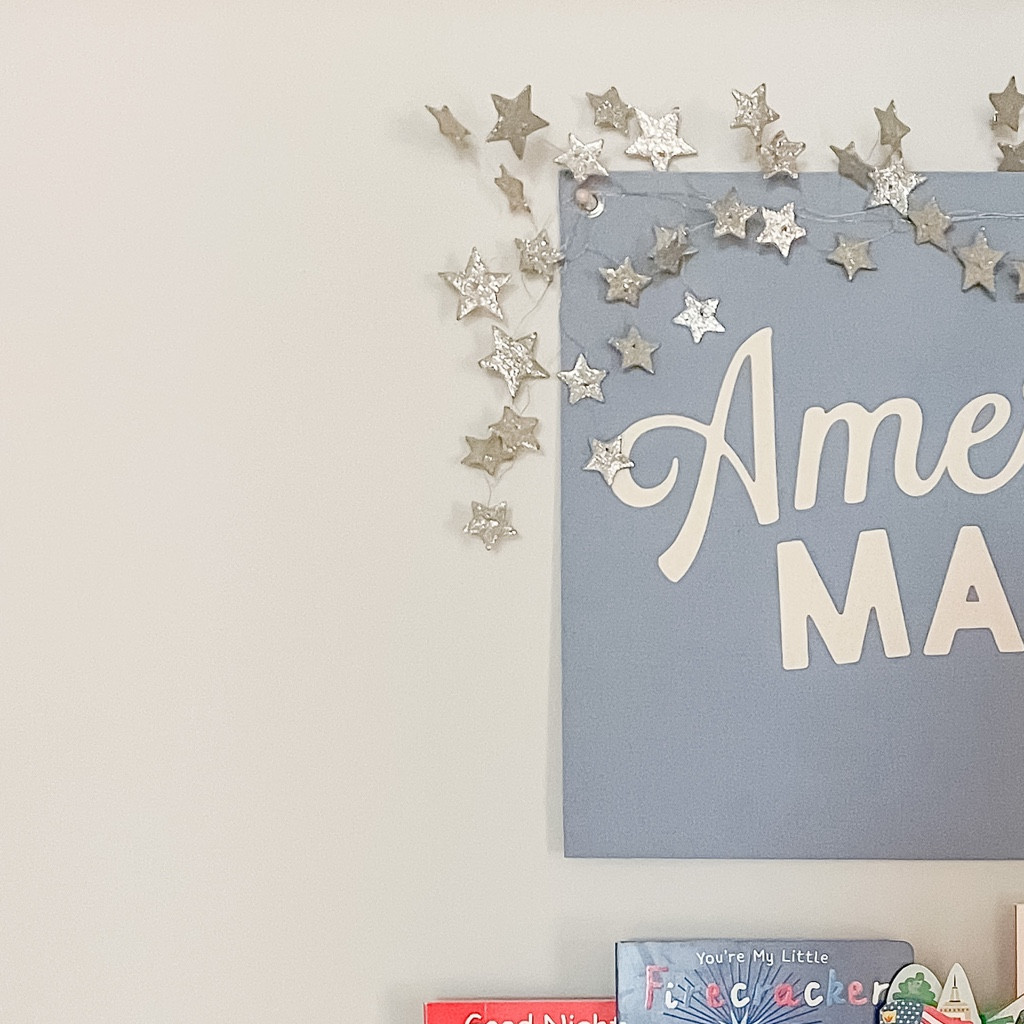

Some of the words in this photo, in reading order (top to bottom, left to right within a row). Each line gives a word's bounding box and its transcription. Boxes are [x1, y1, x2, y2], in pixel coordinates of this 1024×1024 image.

[696, 950, 745, 965] You're
[753, 949, 774, 966] My
[782, 949, 829, 964] Little
[644, 964, 890, 1010] Firecracker
